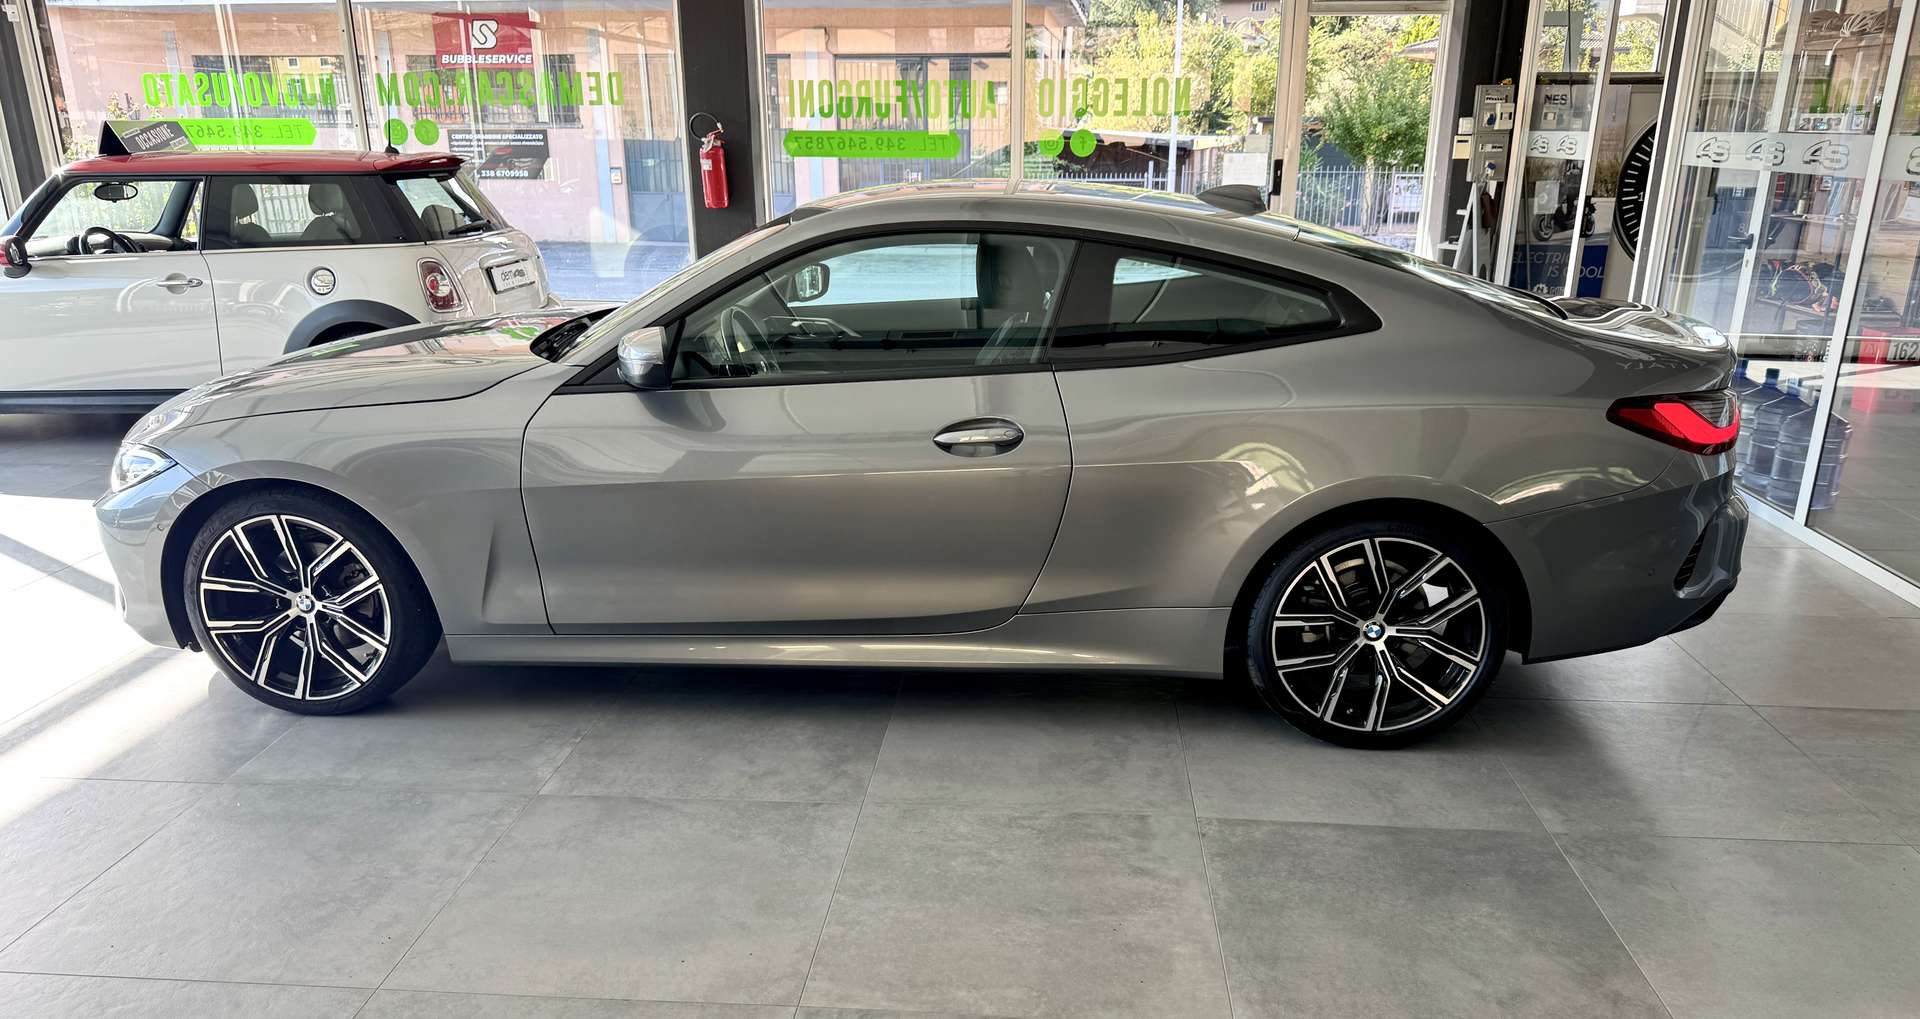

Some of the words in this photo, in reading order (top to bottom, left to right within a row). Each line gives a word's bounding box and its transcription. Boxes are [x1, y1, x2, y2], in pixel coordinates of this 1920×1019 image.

[441, 54, 533, 65] BUBBLESERVICE
[135, 124, 175, 150] OCCASIONE
[1547, 265, 1560, 278] IS
